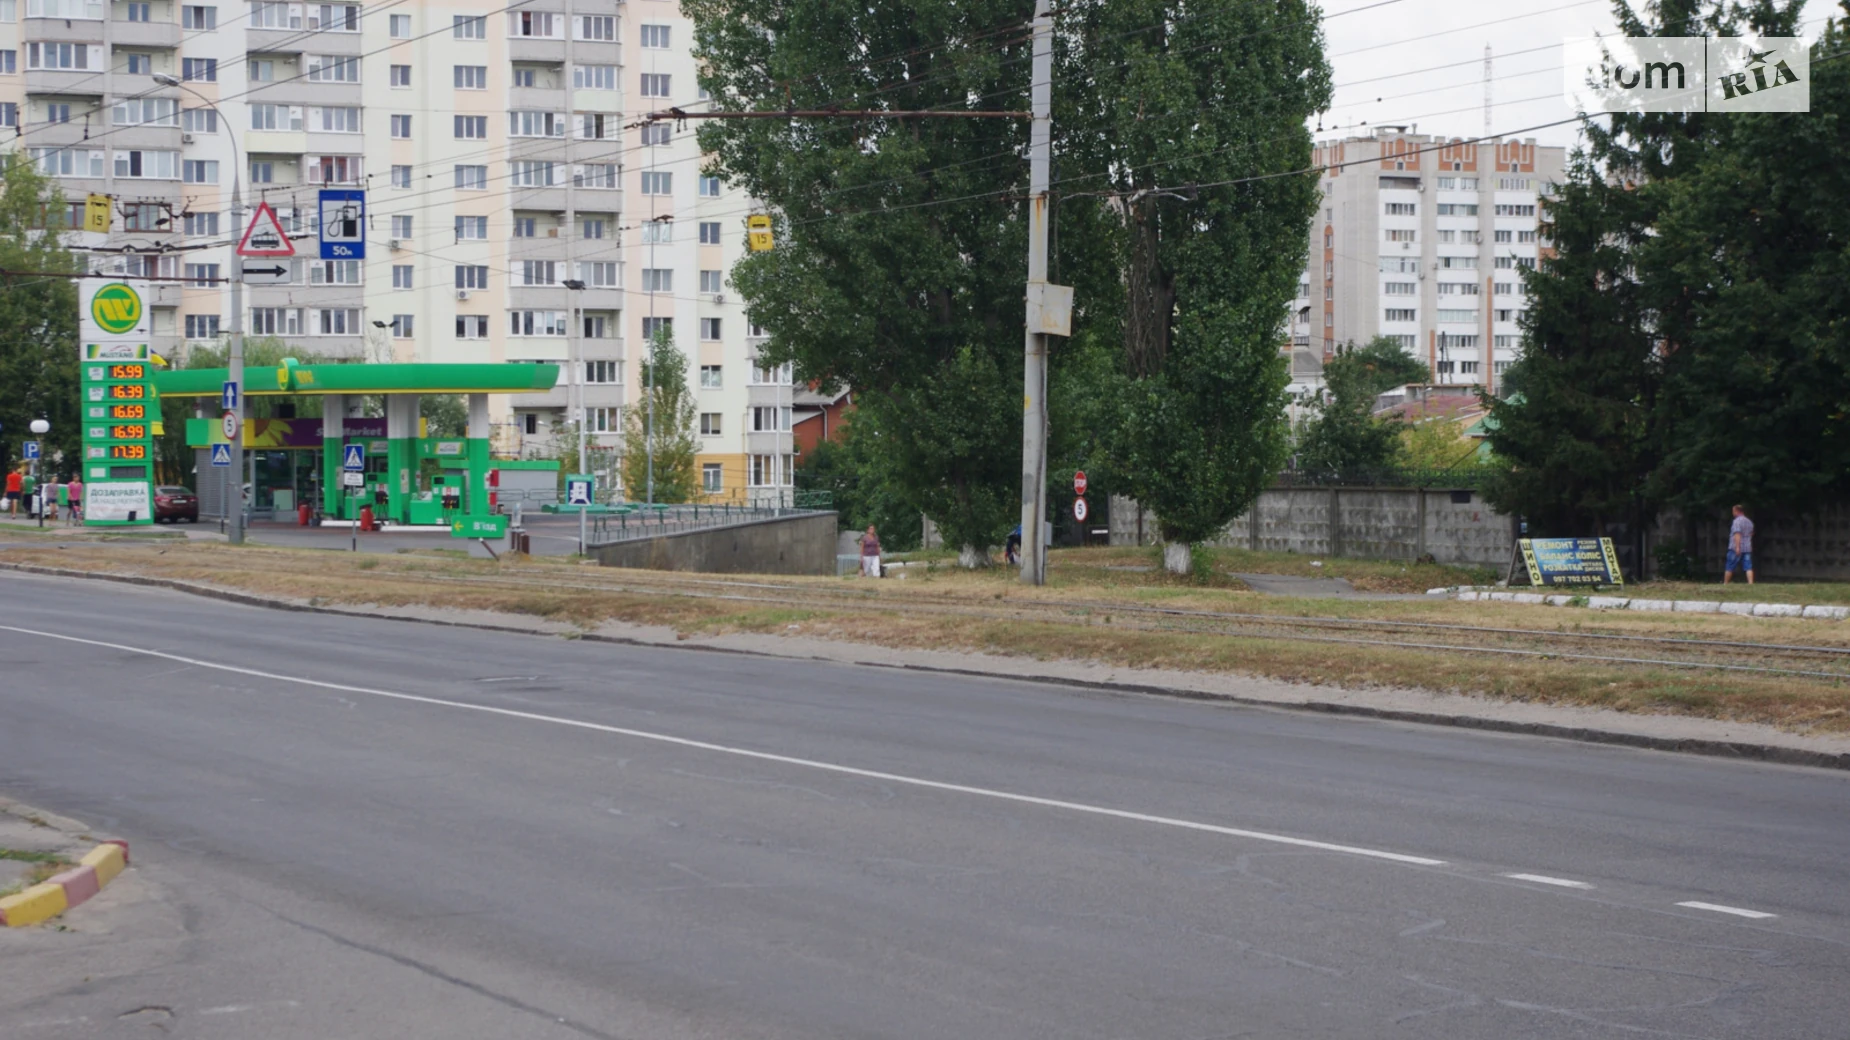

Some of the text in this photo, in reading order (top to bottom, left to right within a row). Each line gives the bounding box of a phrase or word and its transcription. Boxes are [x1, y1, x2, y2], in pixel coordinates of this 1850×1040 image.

[756, 233, 767, 244] 15
[112, 365, 143, 379] 15.99
[112, 385, 143, 399] 16.39
[113, 405, 144, 418] 16.69
[113, 425, 144, 438] 16.99
[227, 419, 233, 432] 5
[28, 443, 38, 457] P
[114, 446, 144, 459] 17.39
[1077, 503, 1083, 515] 5
[1536, 541, 1573, 549] РЕМОНТ
[1540, 552, 1601, 560] БАЛАНС КОЛІС
